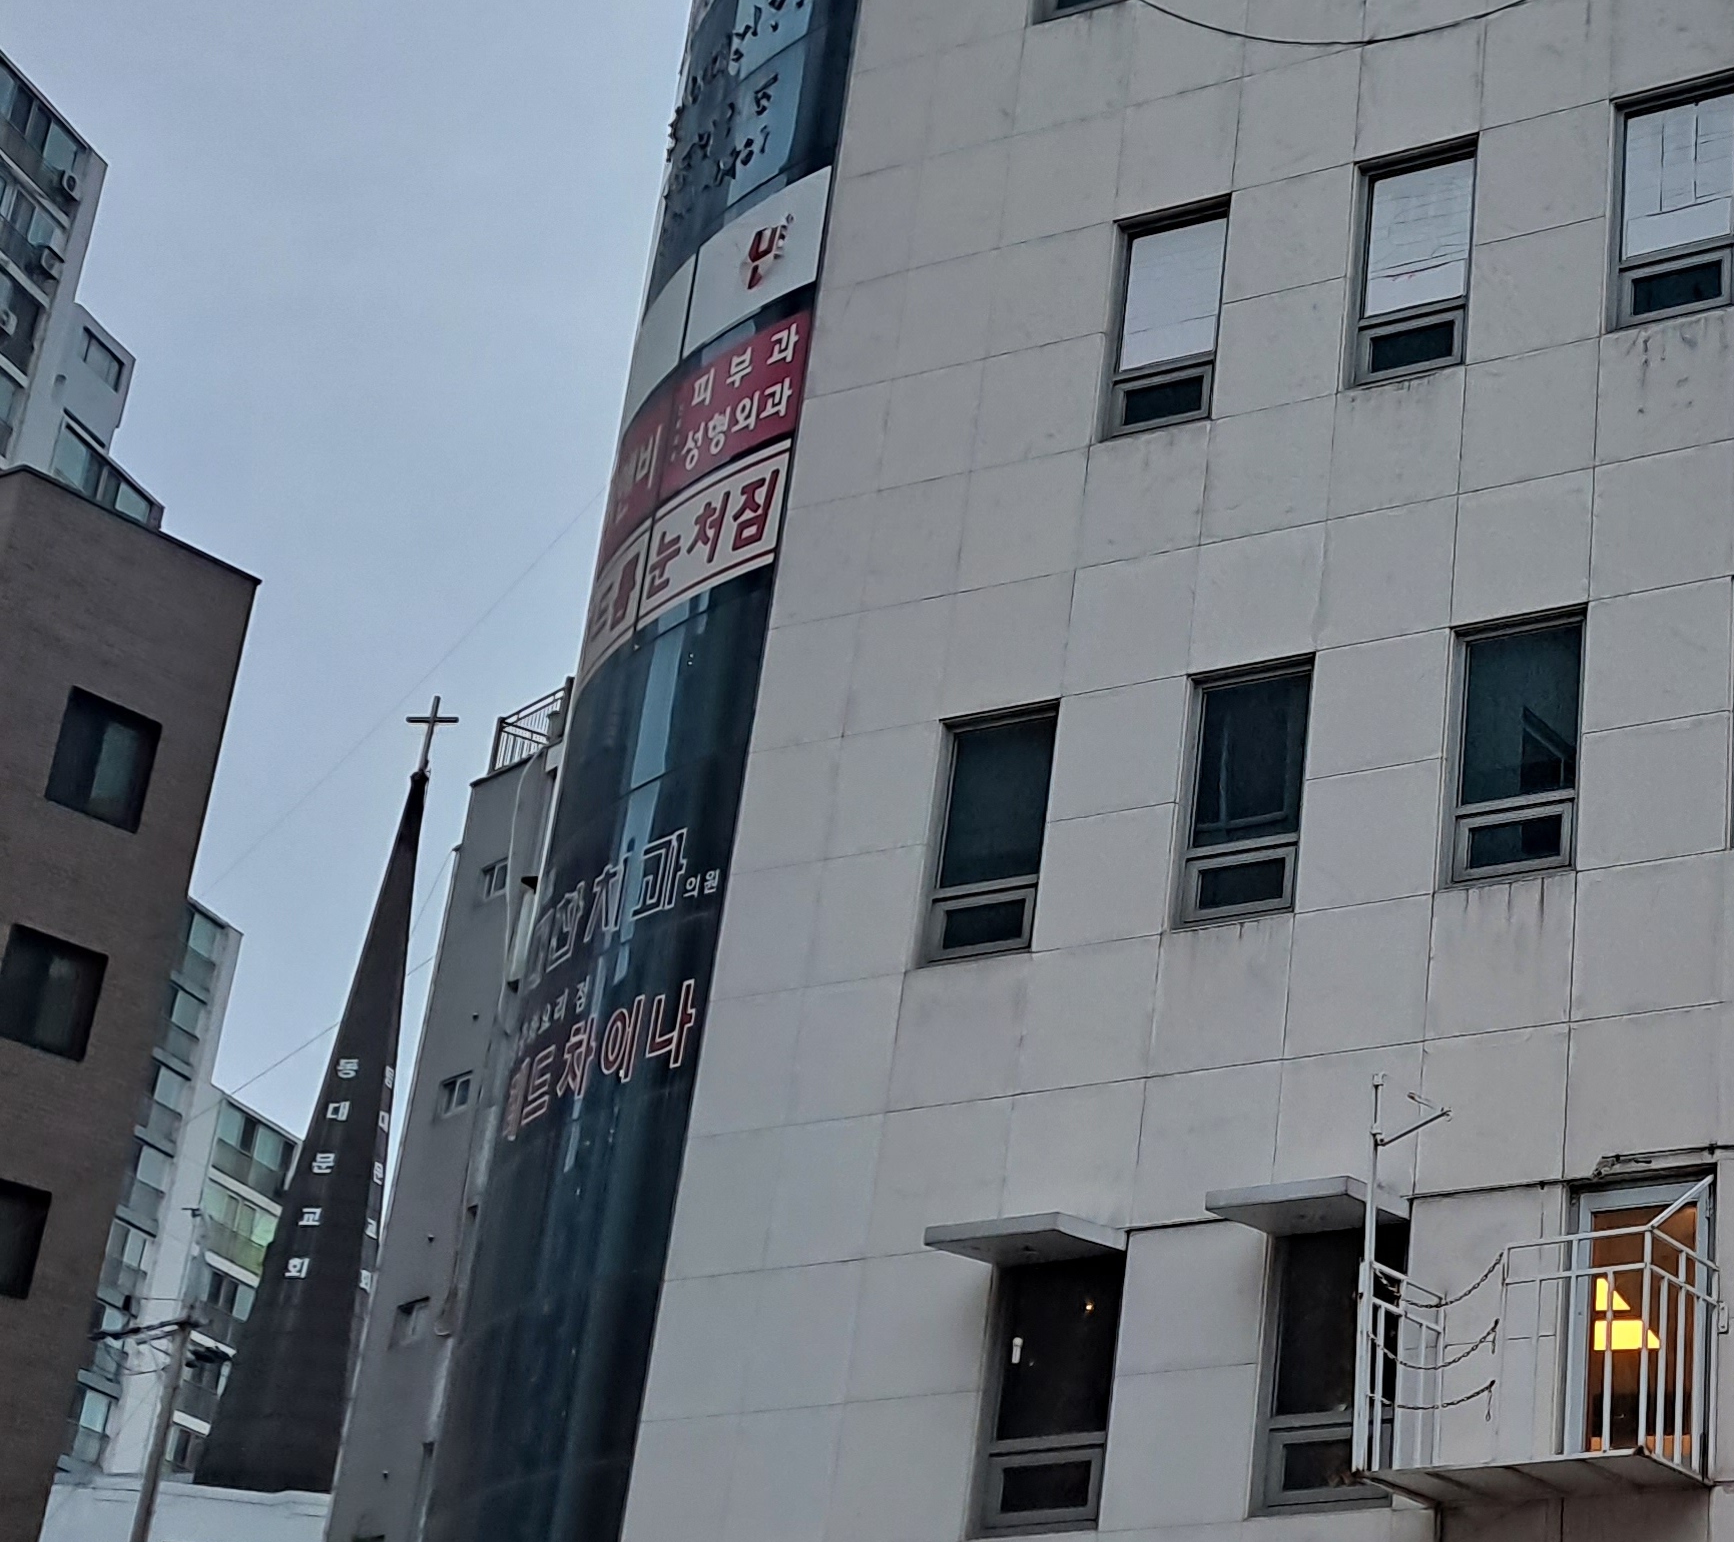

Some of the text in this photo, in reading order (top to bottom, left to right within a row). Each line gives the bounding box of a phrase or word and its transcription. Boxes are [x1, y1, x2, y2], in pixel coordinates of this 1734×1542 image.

[690, 322, 799, 408] 피부과
[681, 377, 793, 472] 성형외과
[285, 1059, 359, 1278] 동대문교회
